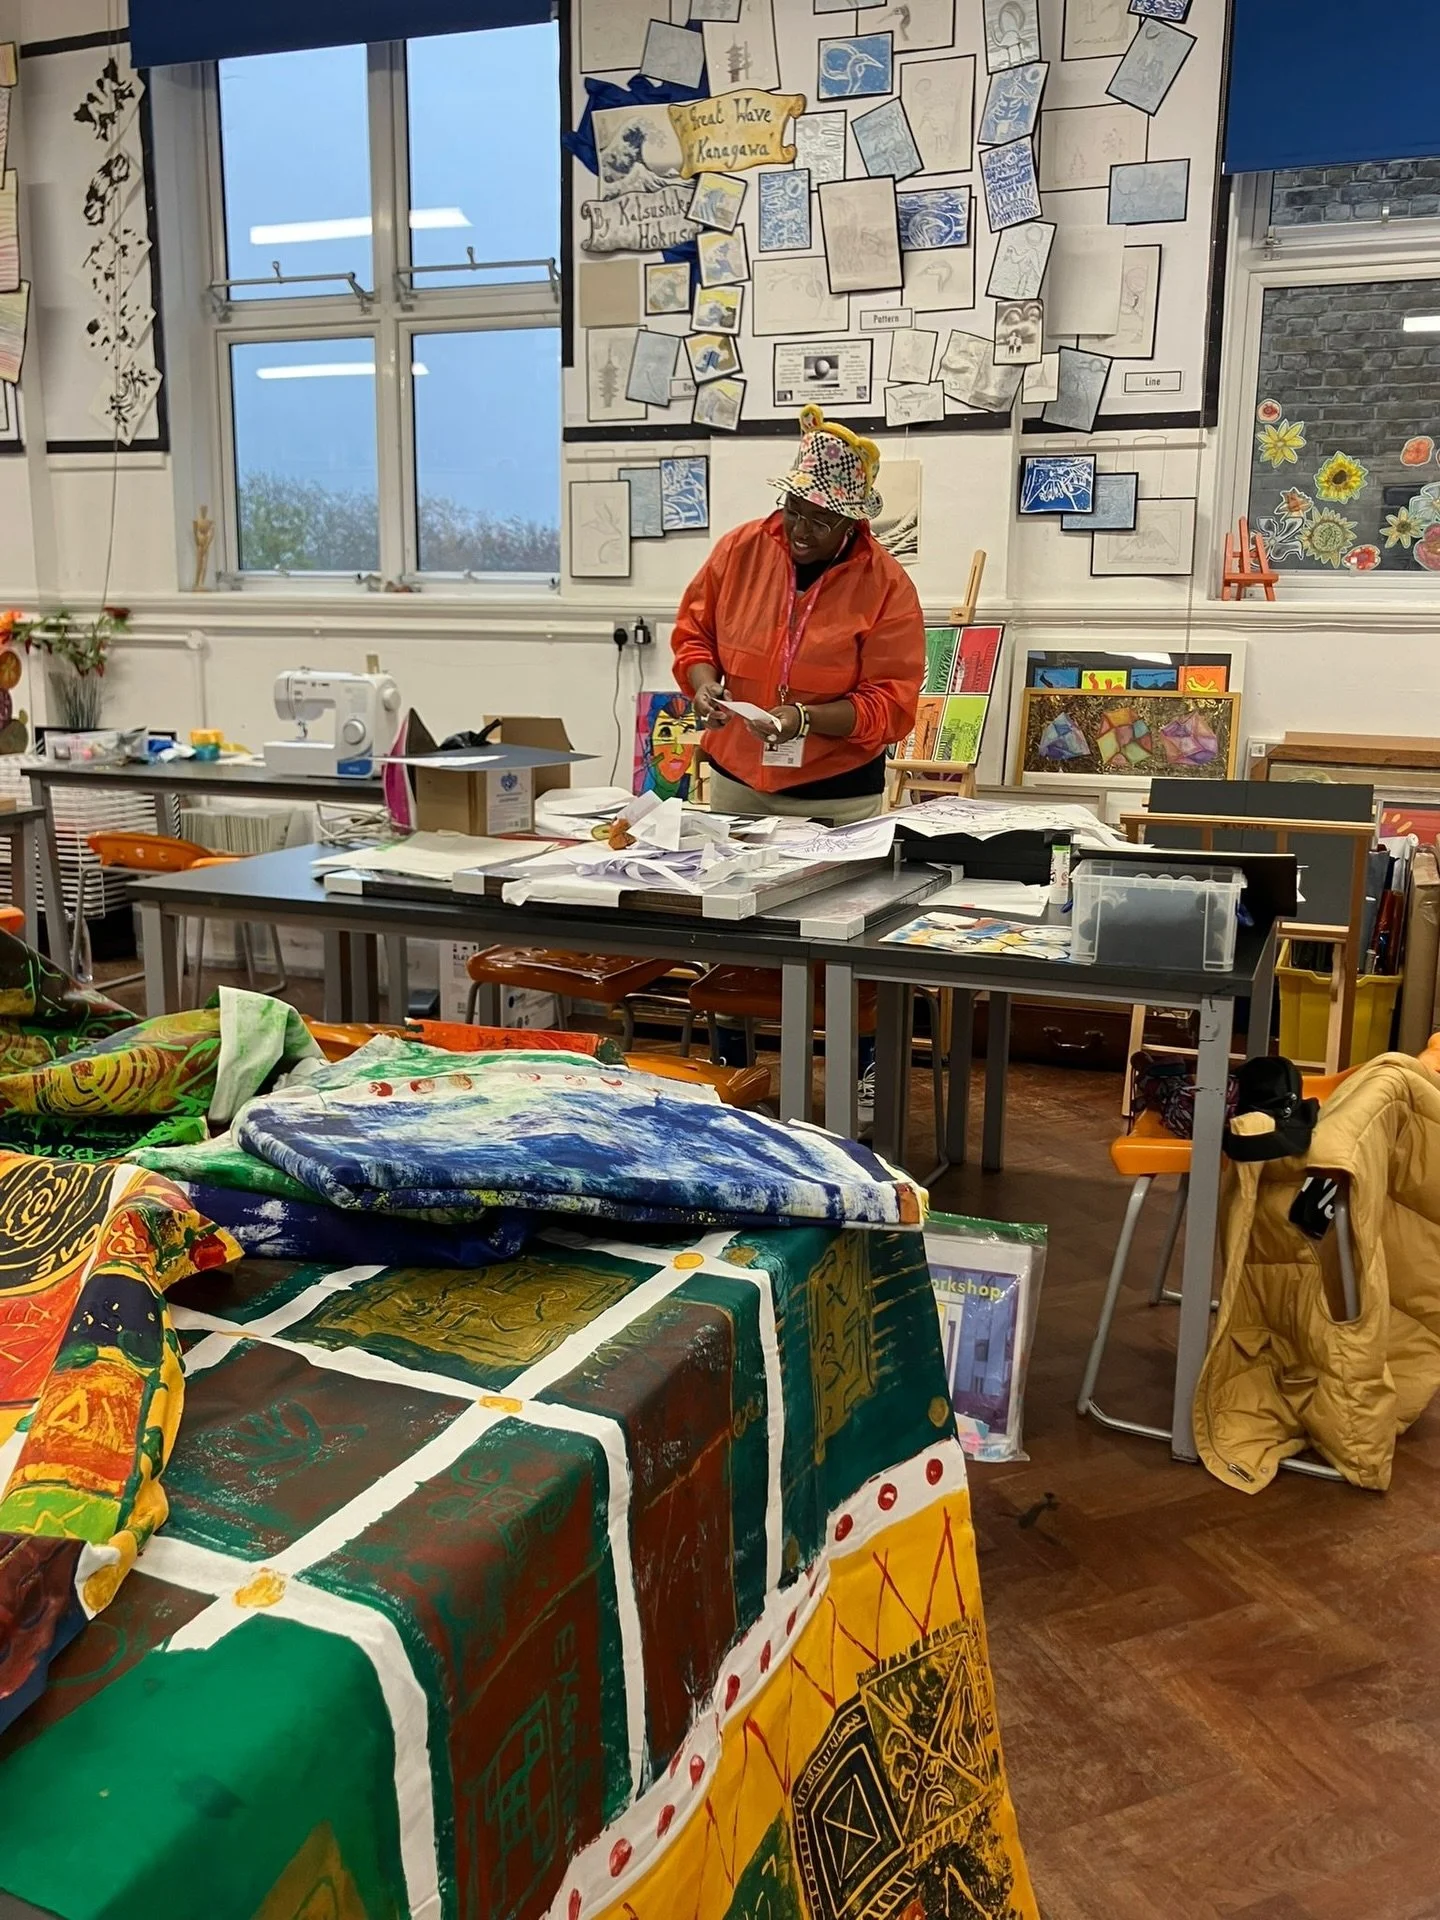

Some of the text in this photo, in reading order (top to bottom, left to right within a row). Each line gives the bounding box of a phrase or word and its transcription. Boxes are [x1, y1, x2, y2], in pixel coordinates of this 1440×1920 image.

[689, 100, 725, 130] Great
[733, 97, 772, 123] Wave
[696, 136, 770, 169] Kanagawa
[593, 207, 611, 238] By
[873, 313, 900, 324] Pattern
[1145, 376, 1161, 387] Line
[931, 1275, 1000, 1301] orkshop
